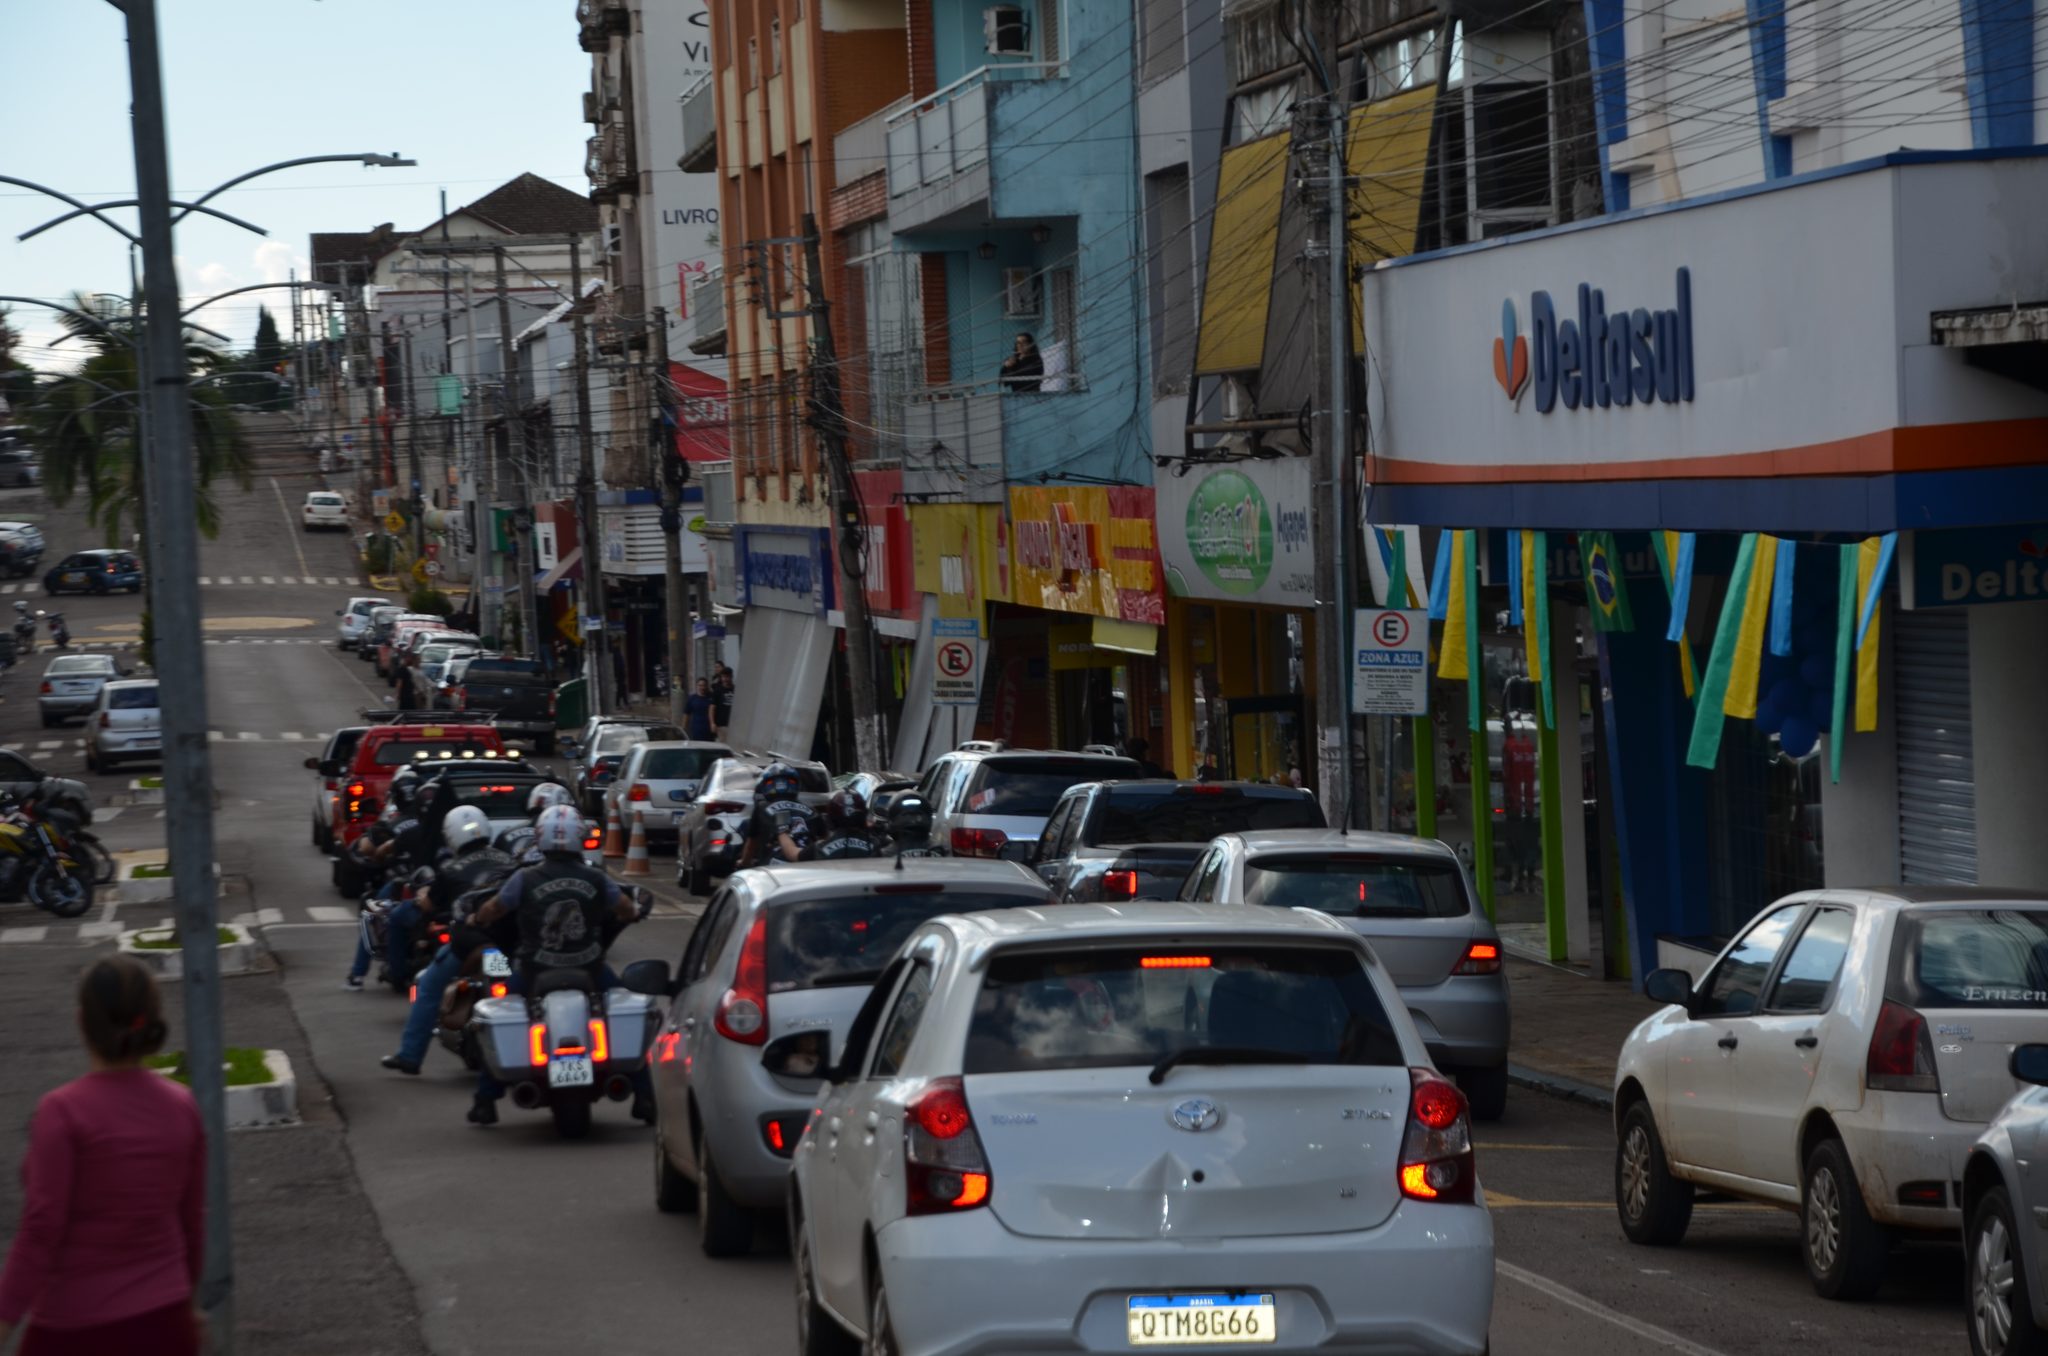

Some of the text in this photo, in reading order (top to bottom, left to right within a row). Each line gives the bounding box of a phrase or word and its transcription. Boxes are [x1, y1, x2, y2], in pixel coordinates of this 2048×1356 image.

[1531, 265, 1695, 414] Deltasul
[1942, 559, 2048, 601] Delt
[1382, 620, 1398, 640] E
[1360, 653, 1420, 664] ZONA AZUL
[1141, 1309, 1259, 1337] QTM8G66
